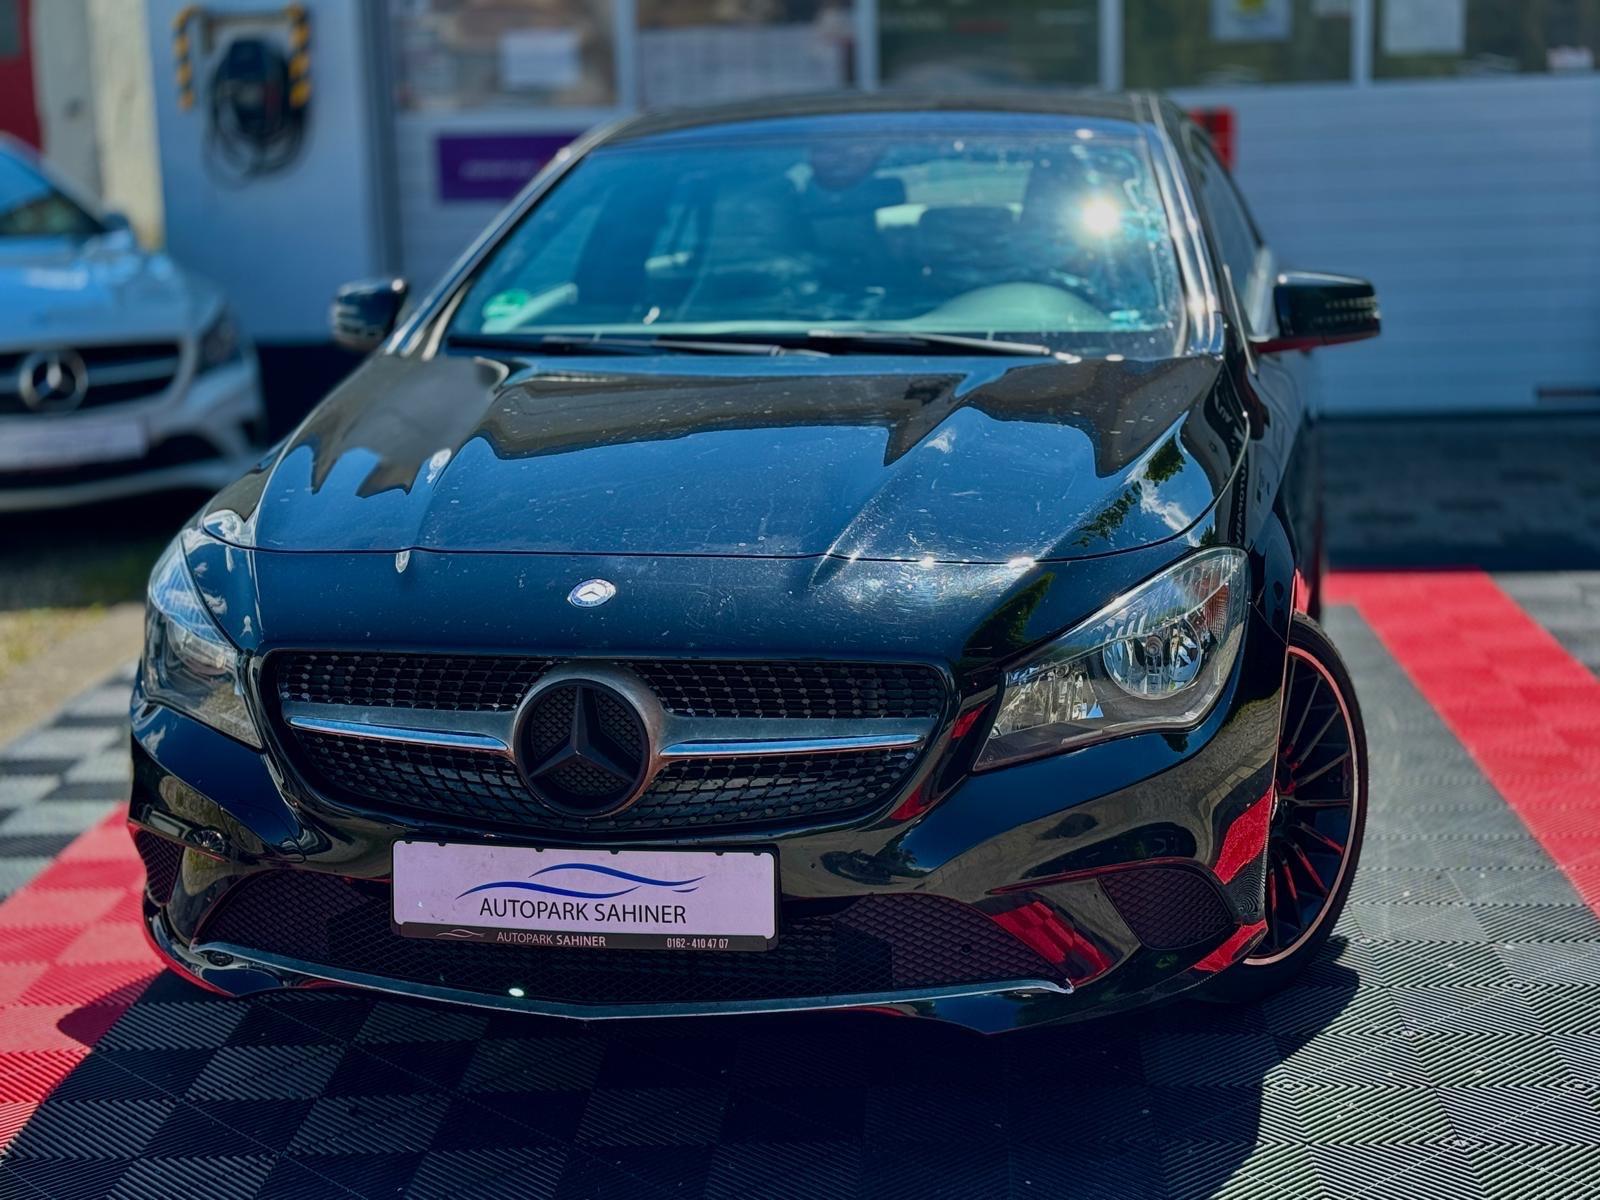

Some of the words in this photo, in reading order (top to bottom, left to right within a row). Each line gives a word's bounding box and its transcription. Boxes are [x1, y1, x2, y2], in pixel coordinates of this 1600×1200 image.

[479, 897, 589, 921] AUTOPARK
[594, 903, 687, 924] SAHINER
[496, 931, 553, 945] AUTOPARK
[556, 934, 606, 947] SAHINER
[707, 938, 717, 949] 47
[718, 938, 729, 949] 07
